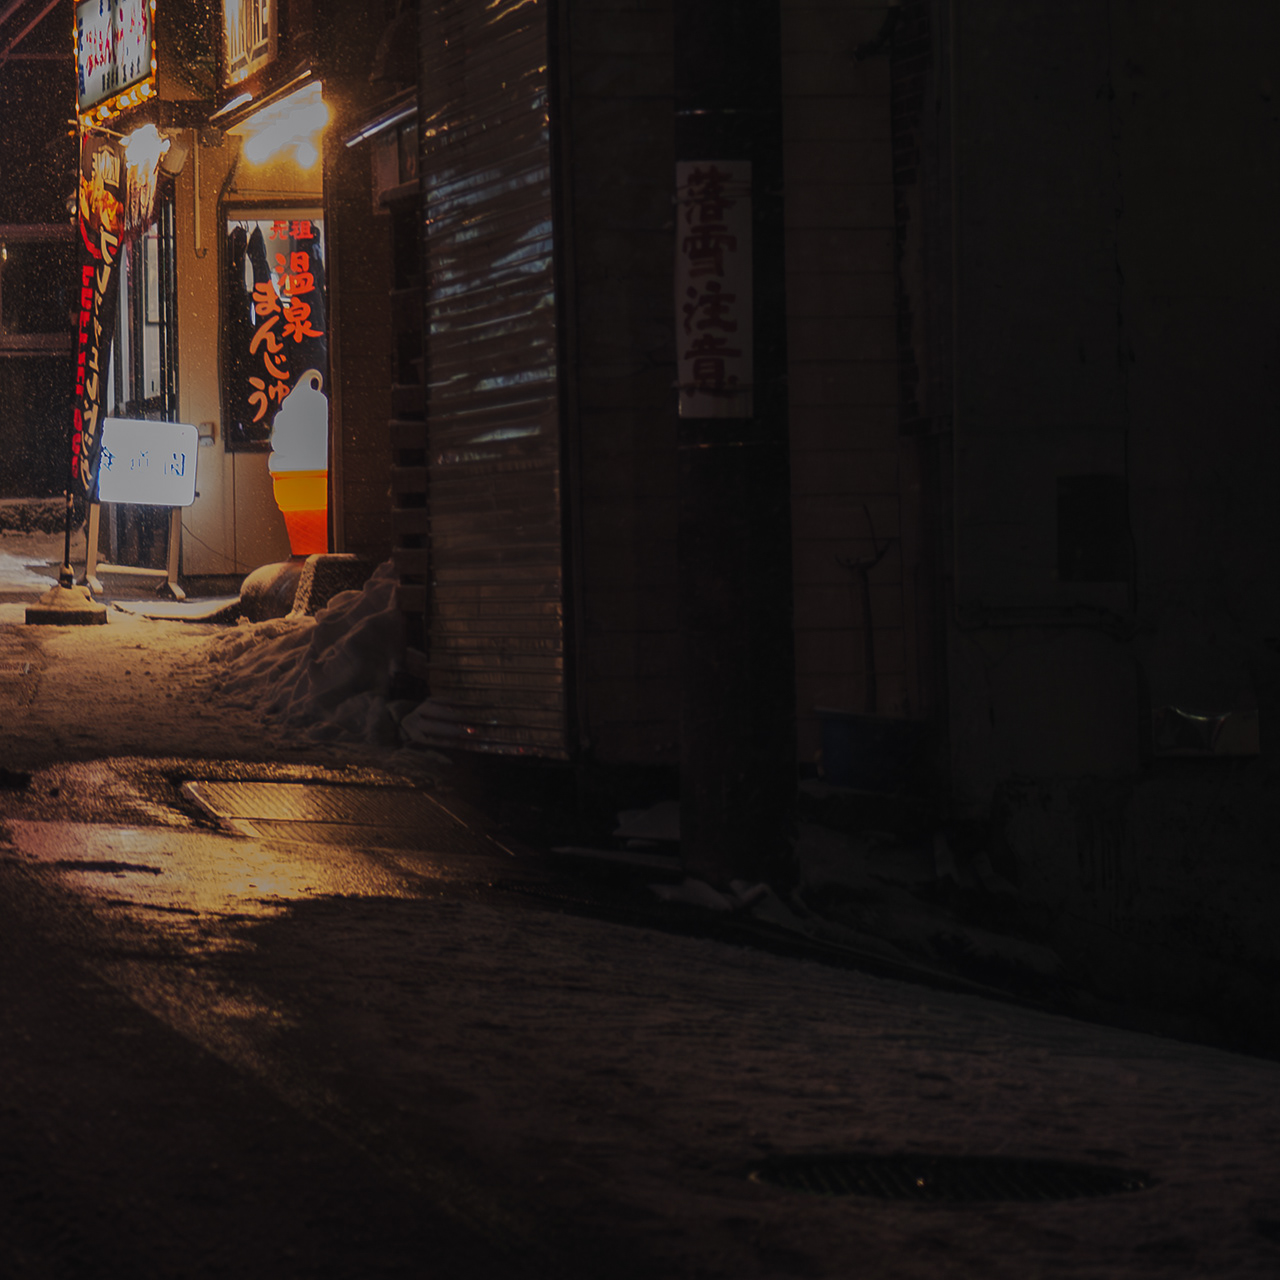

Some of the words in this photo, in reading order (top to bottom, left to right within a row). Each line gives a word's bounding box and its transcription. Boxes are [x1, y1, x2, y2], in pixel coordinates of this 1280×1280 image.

[269, 221, 314, 240] 元祖
[682, 165, 743, 399] 落雪注意
[247, 280, 290, 423] まんじゅう
[276, 251, 324, 343] 温泉
